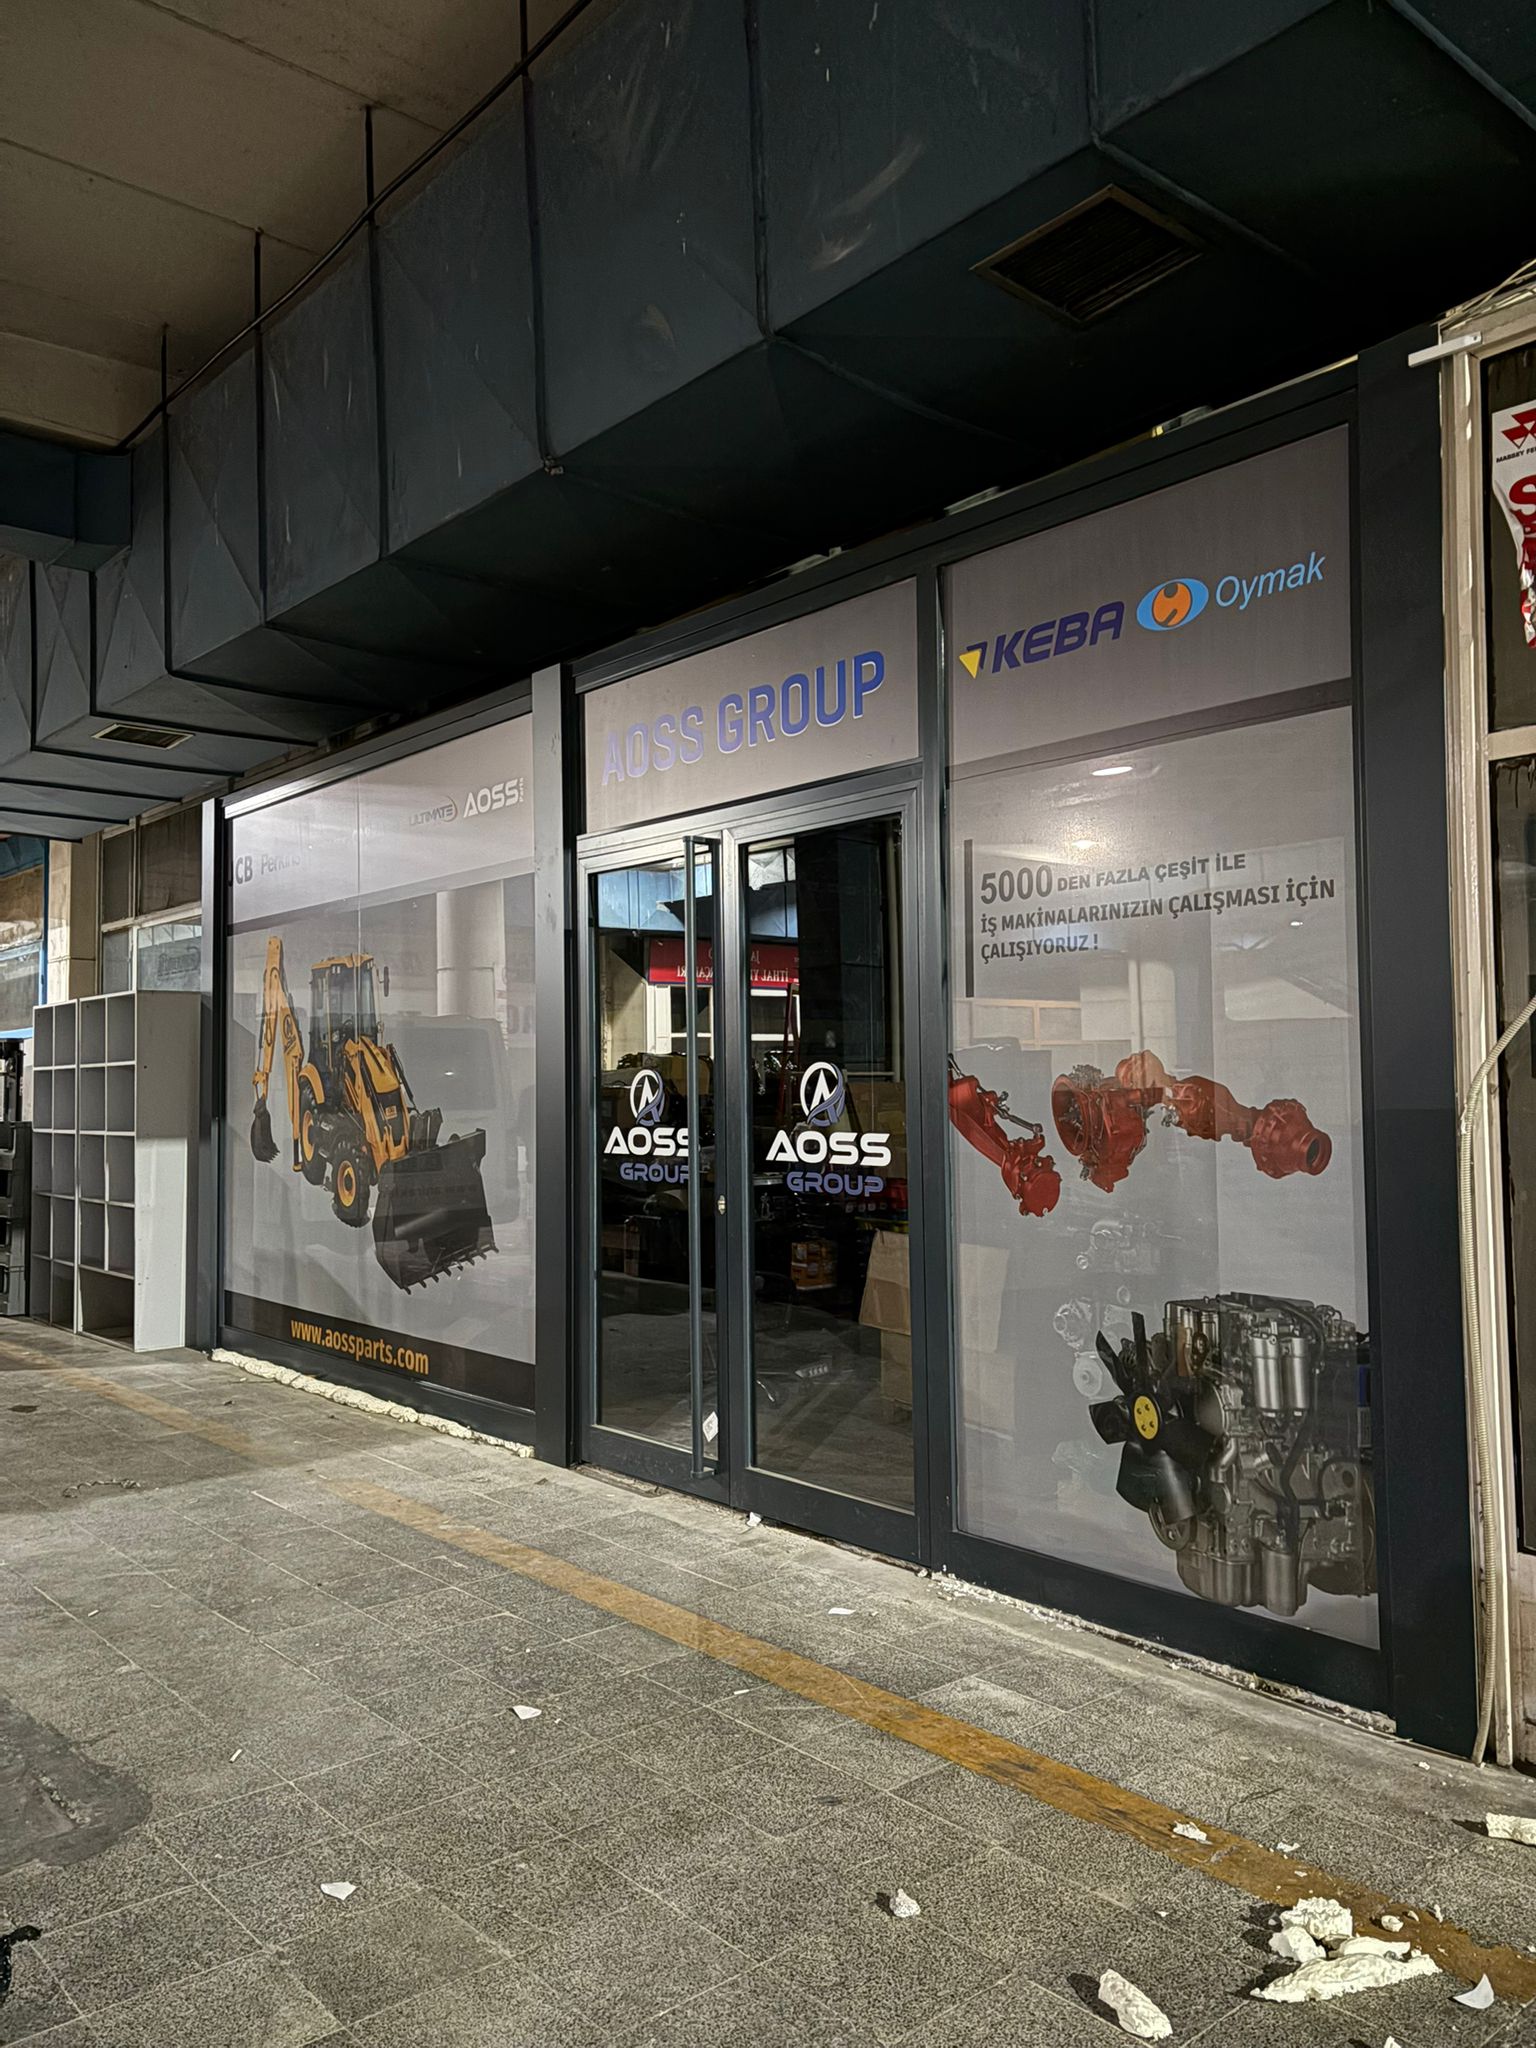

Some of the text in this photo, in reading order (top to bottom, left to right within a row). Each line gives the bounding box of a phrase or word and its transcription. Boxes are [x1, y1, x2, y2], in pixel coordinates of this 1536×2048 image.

[1495, 450, 1525, 463] MASSEY
[1215, 551, 1326, 611] Oymak
[991, 601, 1125, 674] KEBA
[601, 650, 885, 786] AOSS GROUP
[463, 778, 519, 819] AOSS
[980, 852, 1246, 905] 5000 DEN FAZLA ÇEŞİT İLE
[980, 874, 1335, 937] İŞ MAKİNALARINIZIN ÇALIŞMASI İÇİN
[980, 934, 1089, 964] ÇALIŞIYORUZ
[765, 1129, 892, 1167] AOSS
[786, 1171, 885, 1197] GROUP
[290, 1319, 429, 1375] www.aossparts.com
